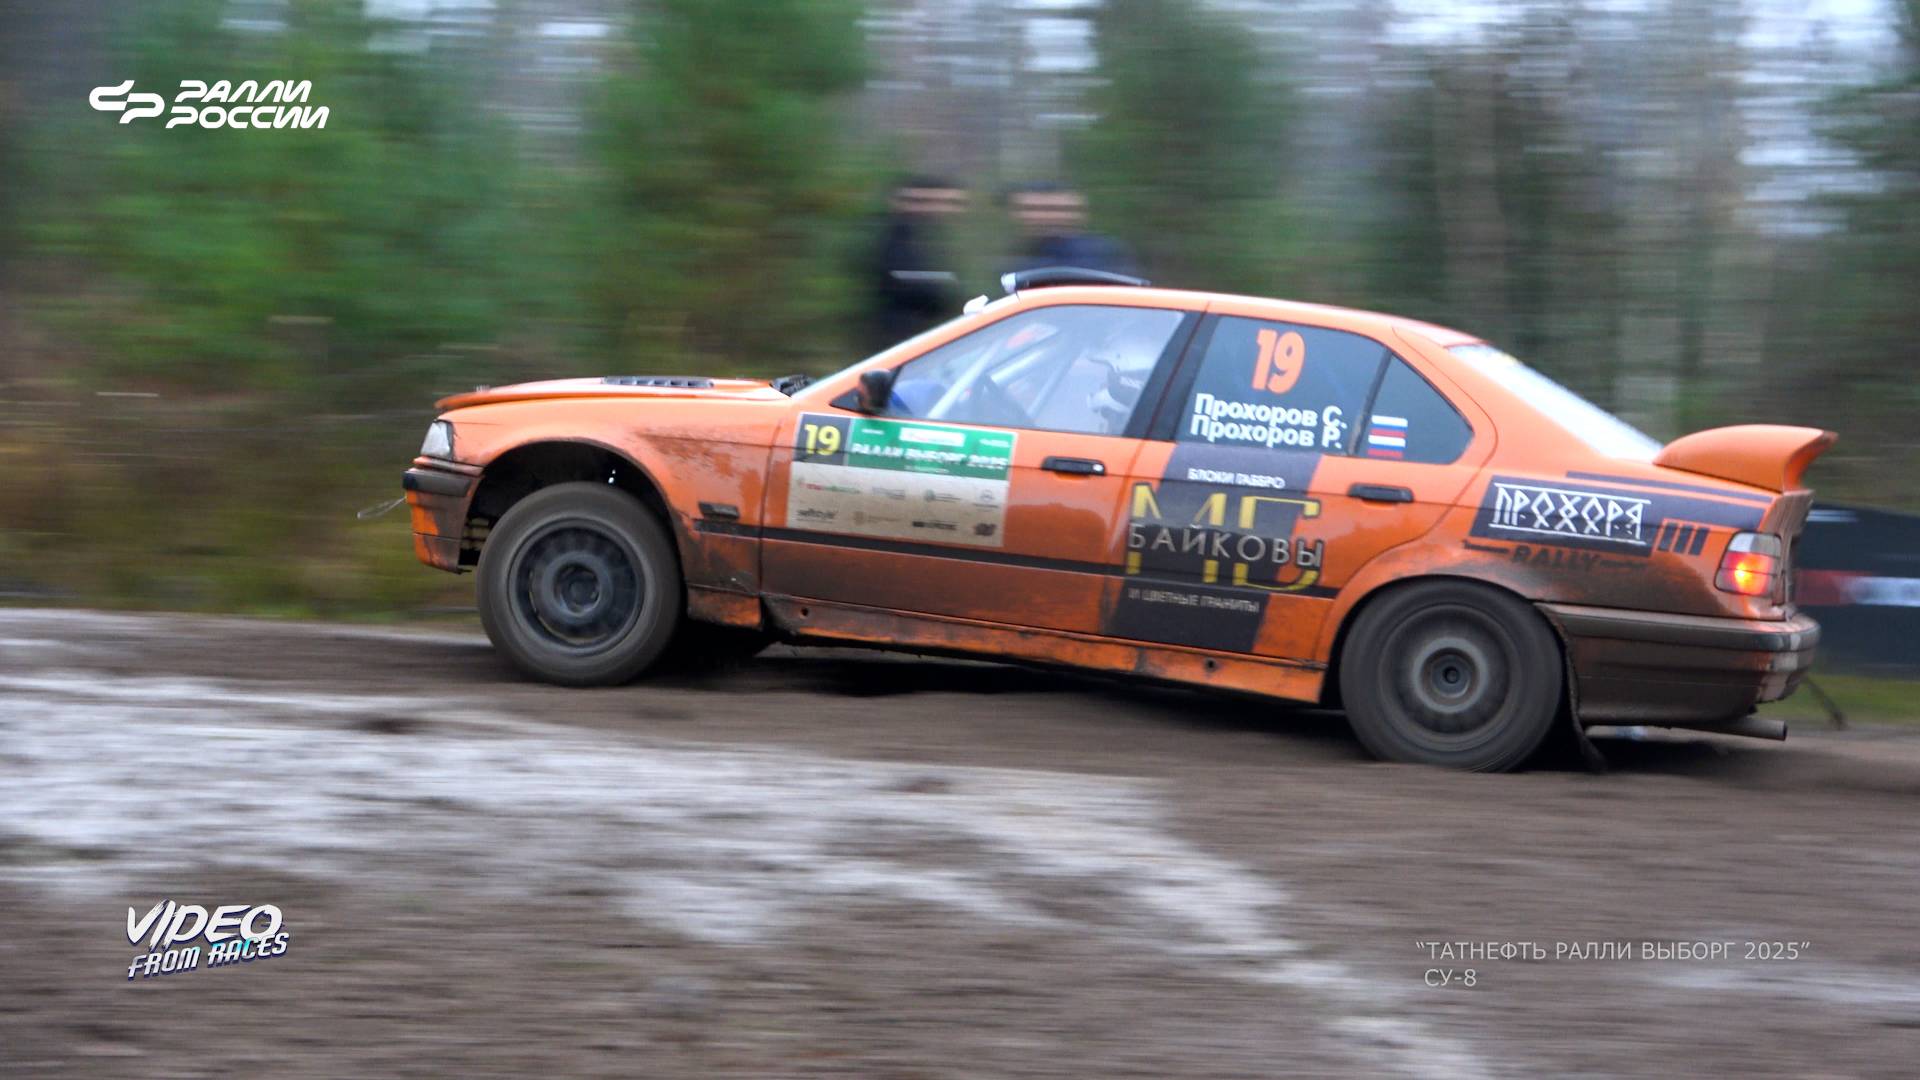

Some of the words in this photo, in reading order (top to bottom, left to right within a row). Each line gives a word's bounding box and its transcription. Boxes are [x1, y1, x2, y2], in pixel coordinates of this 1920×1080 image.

[1252, 328, 1305, 394] 19
[1194, 393, 1318, 427] Прохоров
[1322, 405, 1347, 429] С.
[803, 424, 841, 456] 19
[1190, 414, 1315, 448] Прохоров
[1321, 425, 1342, 449] Р.
[1128, 519, 1324, 568] БАЙКОВЫ
